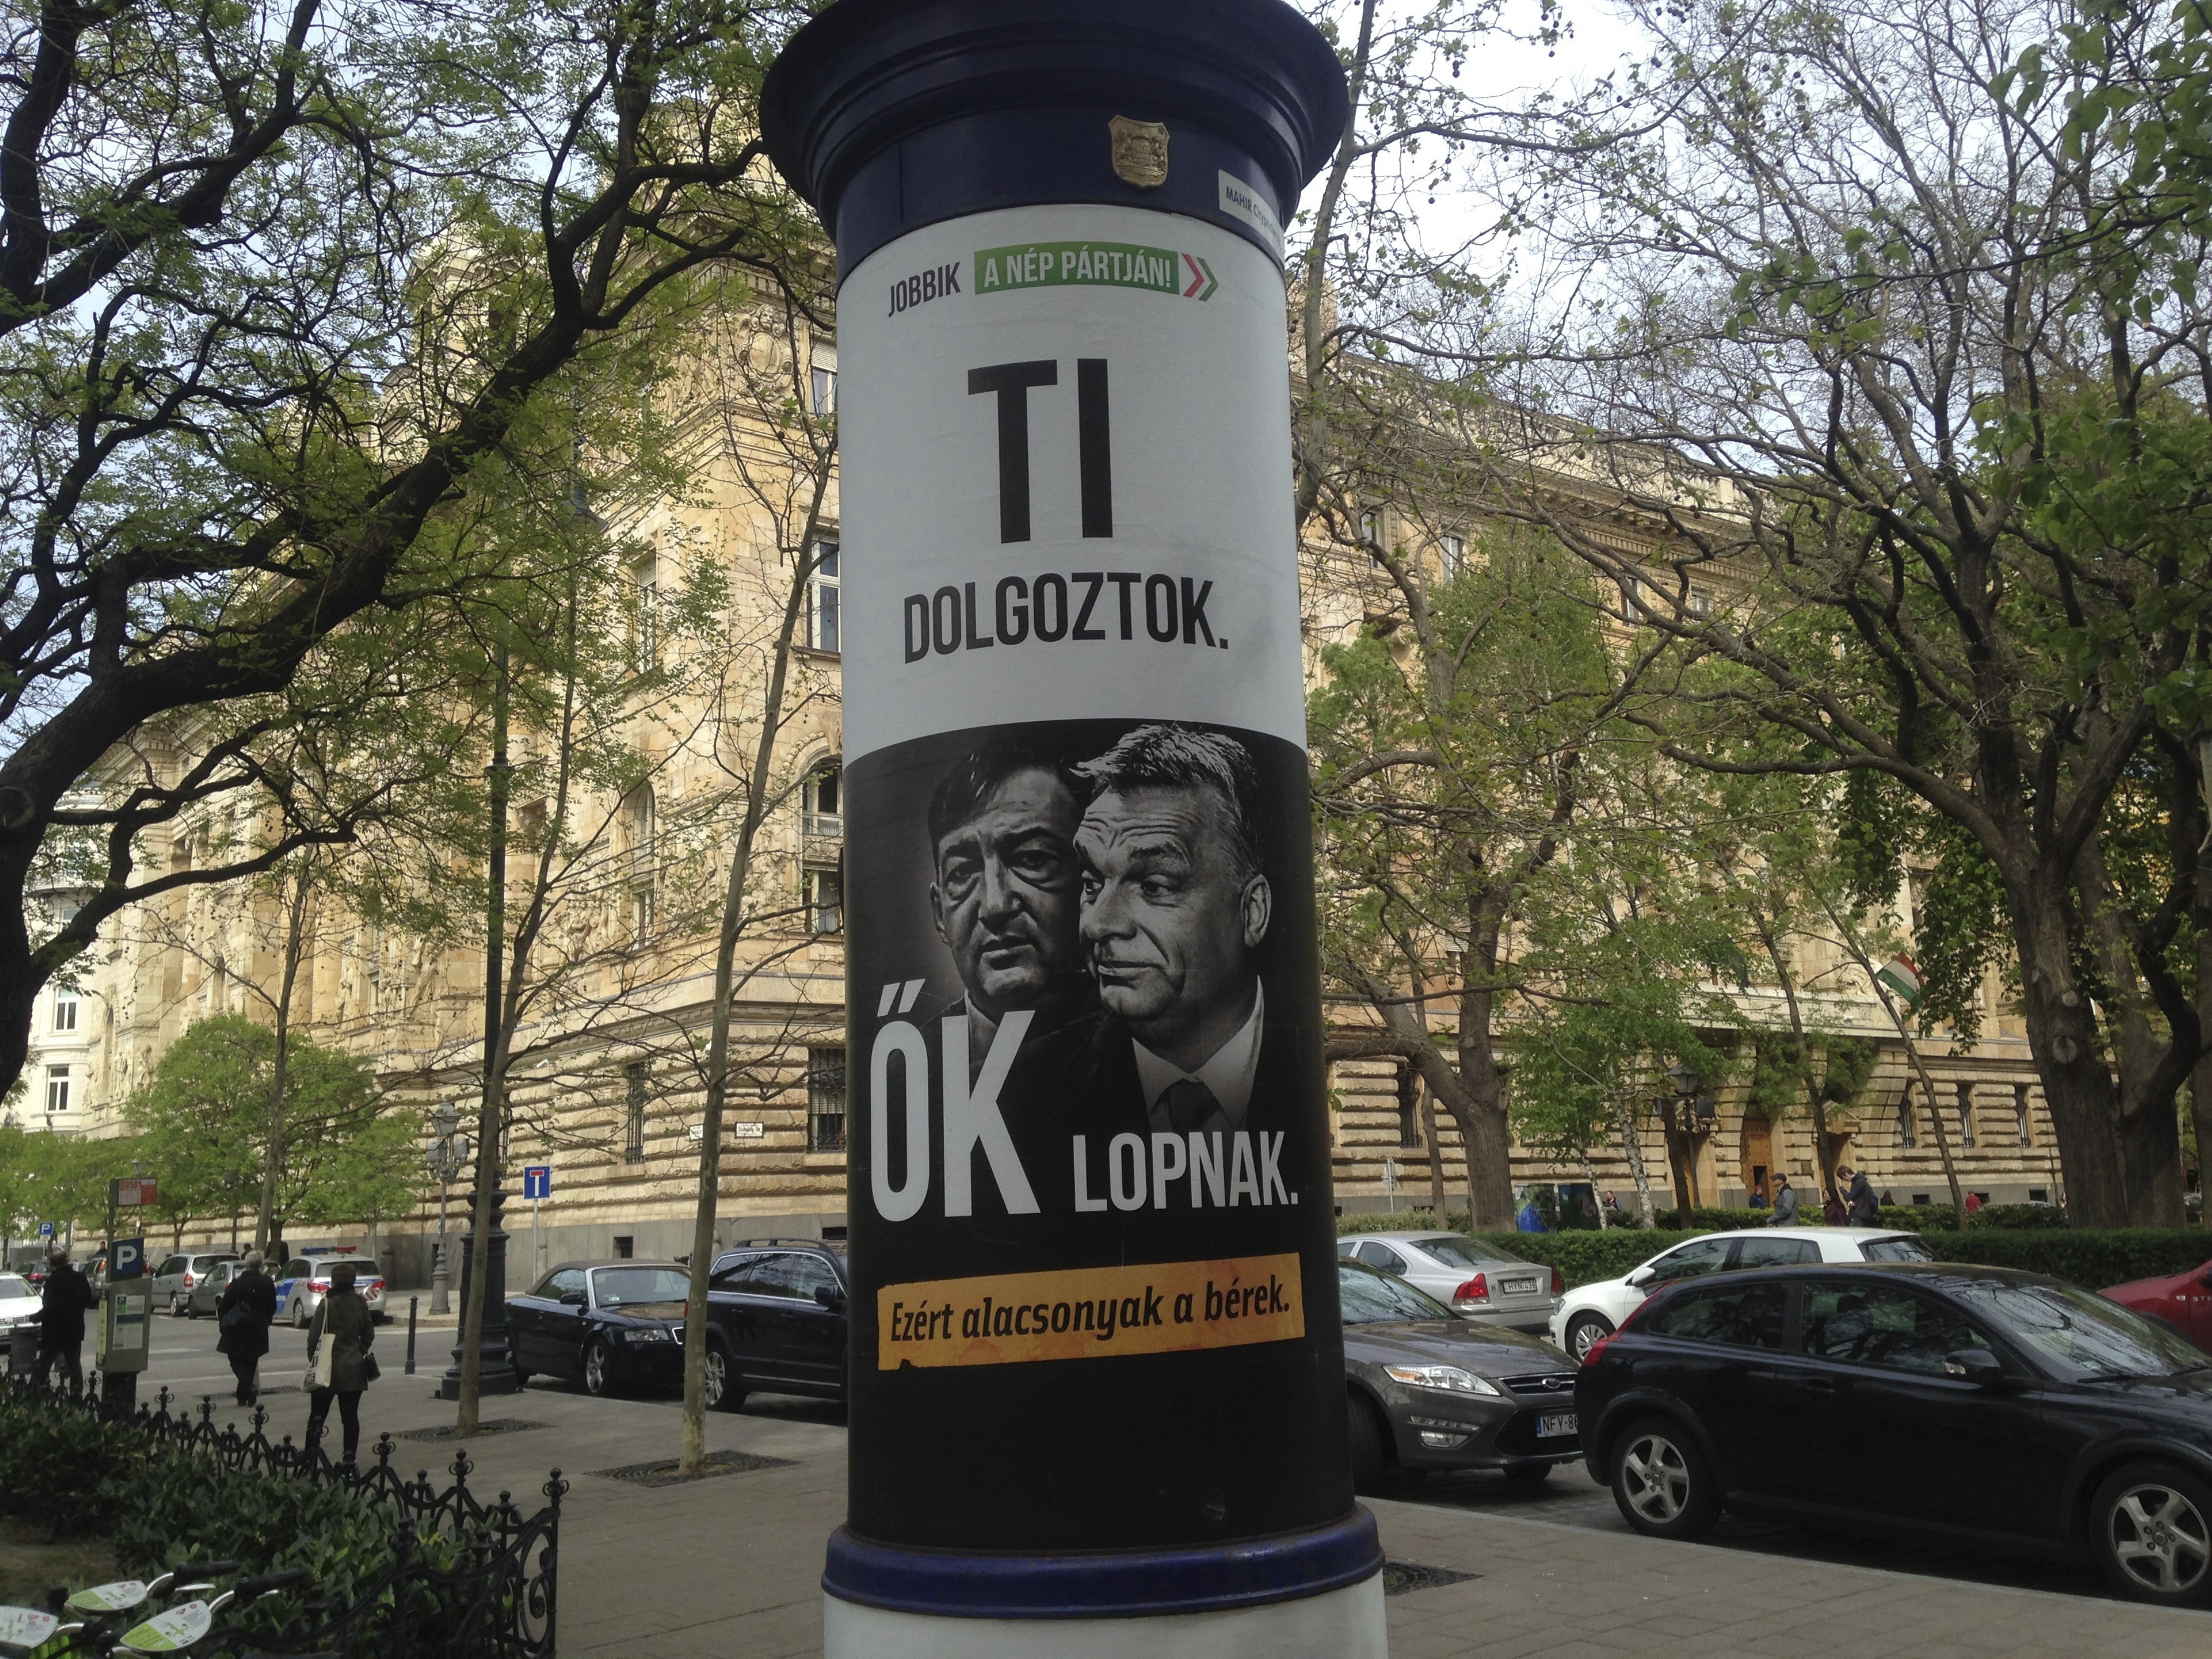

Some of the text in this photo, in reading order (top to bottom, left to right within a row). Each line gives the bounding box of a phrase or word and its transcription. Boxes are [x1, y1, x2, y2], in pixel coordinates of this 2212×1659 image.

[1225, 186, 1252, 213] MAHIR
[888, 245, 1171, 318] JOBBIK A NÉP PÁRTJÁN!
[967, 358, 1113, 544] TI
[904, 571, 1229, 664] DOLGOZTOK.
[870, 979, 1298, 1222] ŐK LOPNAK.
[41, 1223, 50, 1233] P
[117, 1245, 138, 1270] P
[890, 1274, 1290, 1342] Ezért alacsonyak a bérek.
